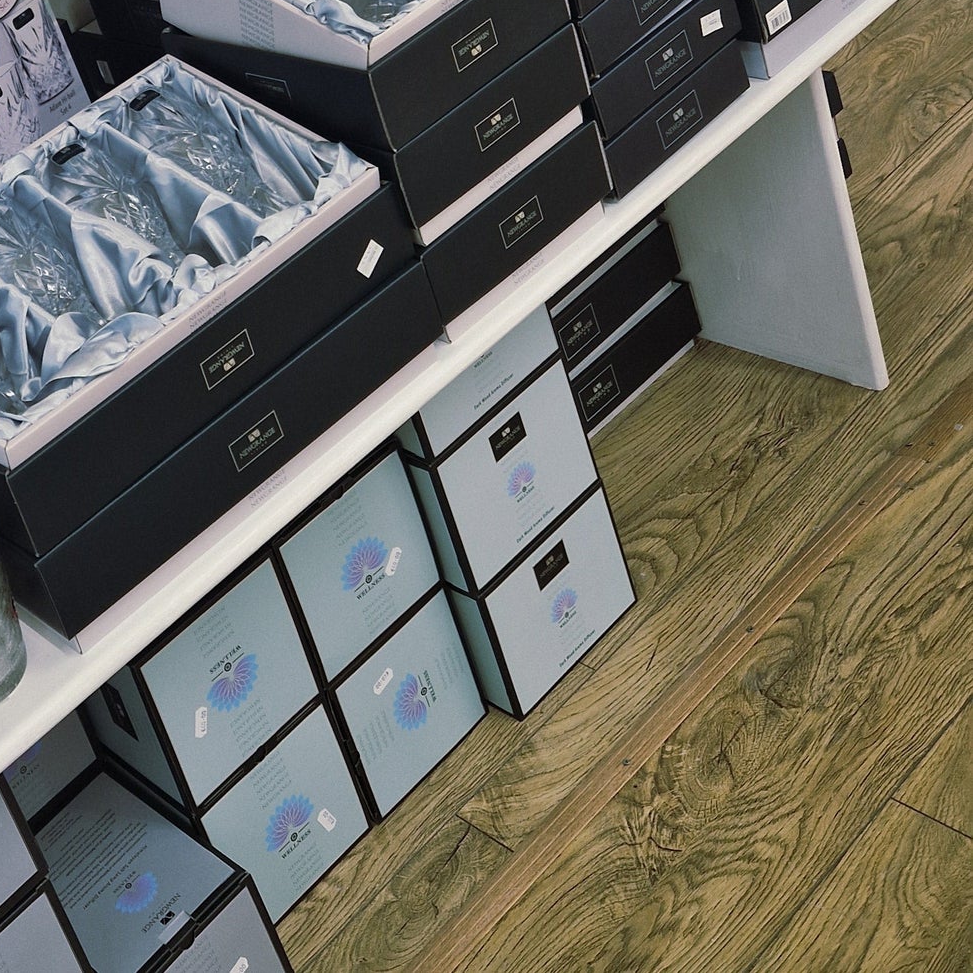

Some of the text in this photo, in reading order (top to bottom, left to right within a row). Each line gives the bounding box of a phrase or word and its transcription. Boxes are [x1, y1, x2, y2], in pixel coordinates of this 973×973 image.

[459, 30, 490, 58] NEWGRANGE
[654, 47, 688, 79] NEWGRANGE
[483, 113, 514, 141] NEWGRANGE
[665, 106, 698, 137] NEWGRANGE
[507, 209, 538, 239] NEWGRANGE
[208, 341, 246, 375] NEWGRANGE
[239, 426, 276, 459] NEWGRANGE
[357, 573, 387, 601] WELLNESS
[209, 644, 242, 675] WELLNESS
[281, 829, 312, 860] WELLNESS
[141, 892, 182, 933] NEWGRANGE
